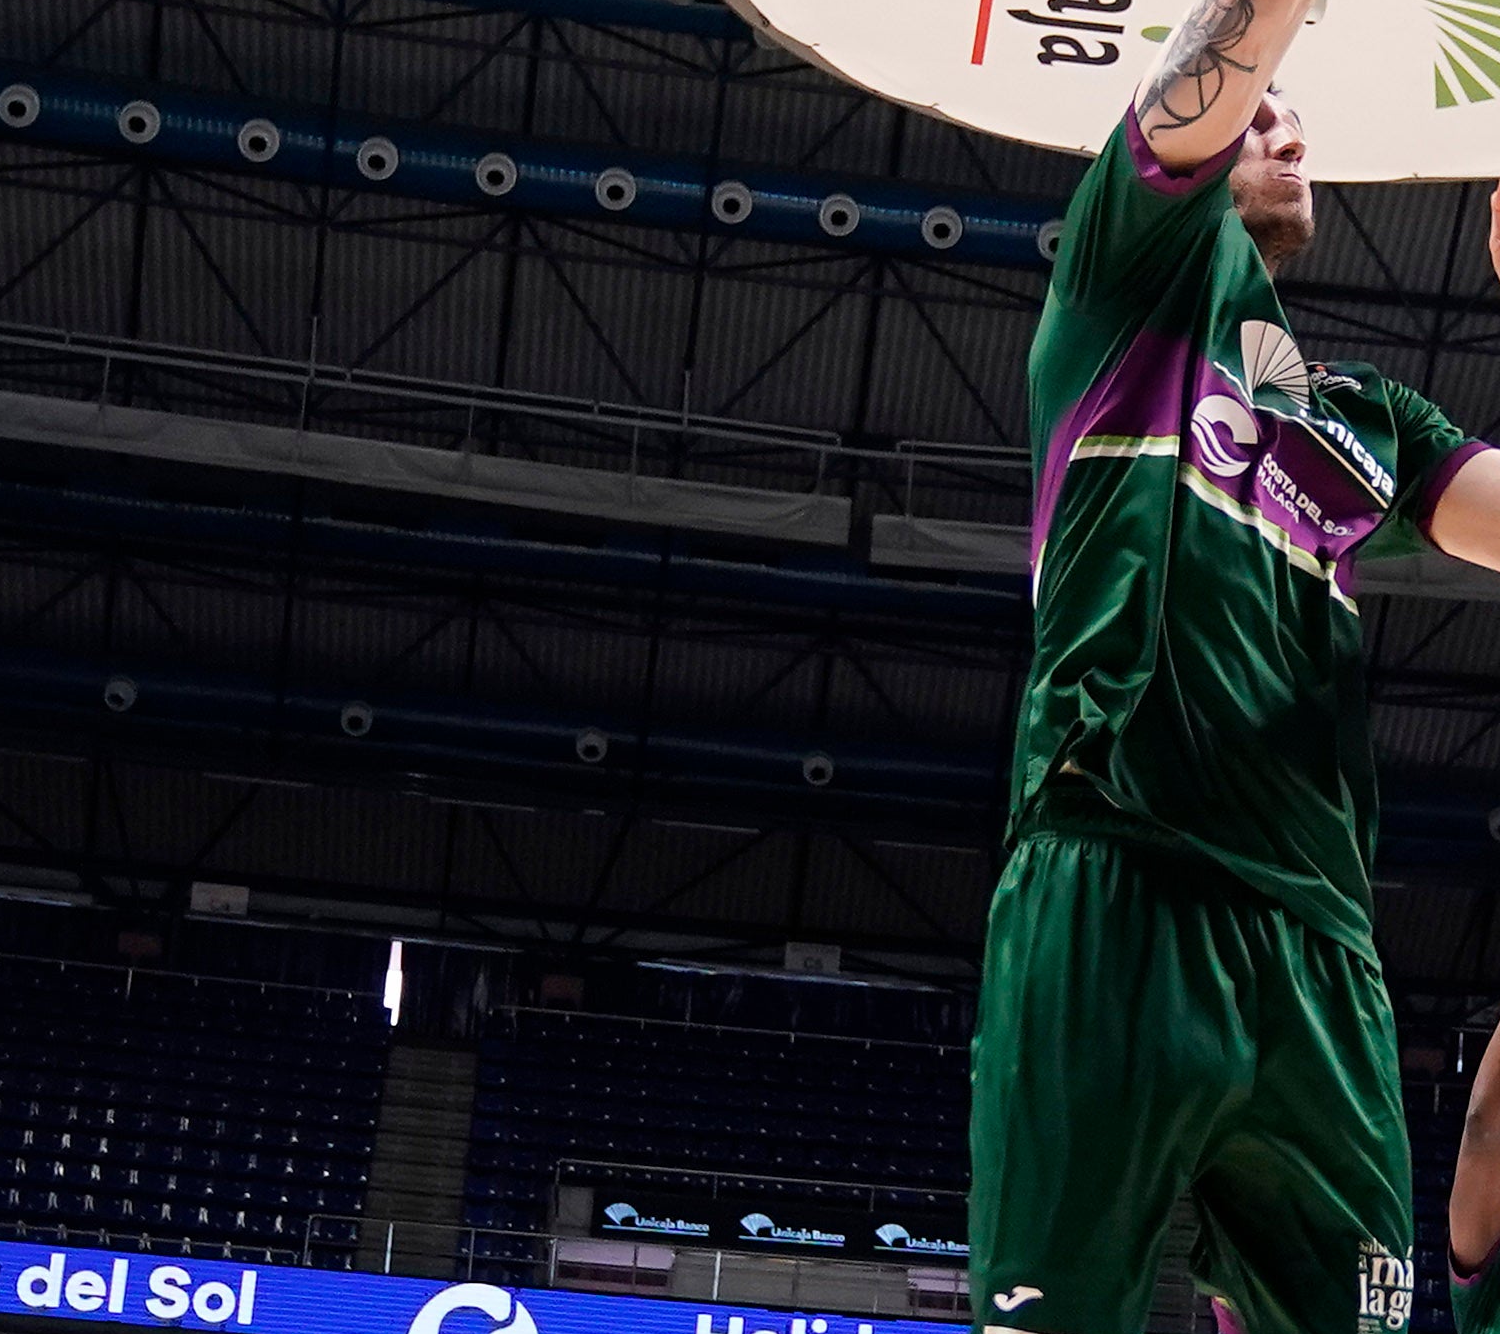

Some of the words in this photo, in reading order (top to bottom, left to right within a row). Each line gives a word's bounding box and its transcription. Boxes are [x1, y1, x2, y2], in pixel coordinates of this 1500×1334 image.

[1262, 453, 1298, 501] COSTA
[1296, 492, 1324, 526] DEL
[18, 1253, 127, 1317] del
[147, 1267, 257, 1326] Sol
